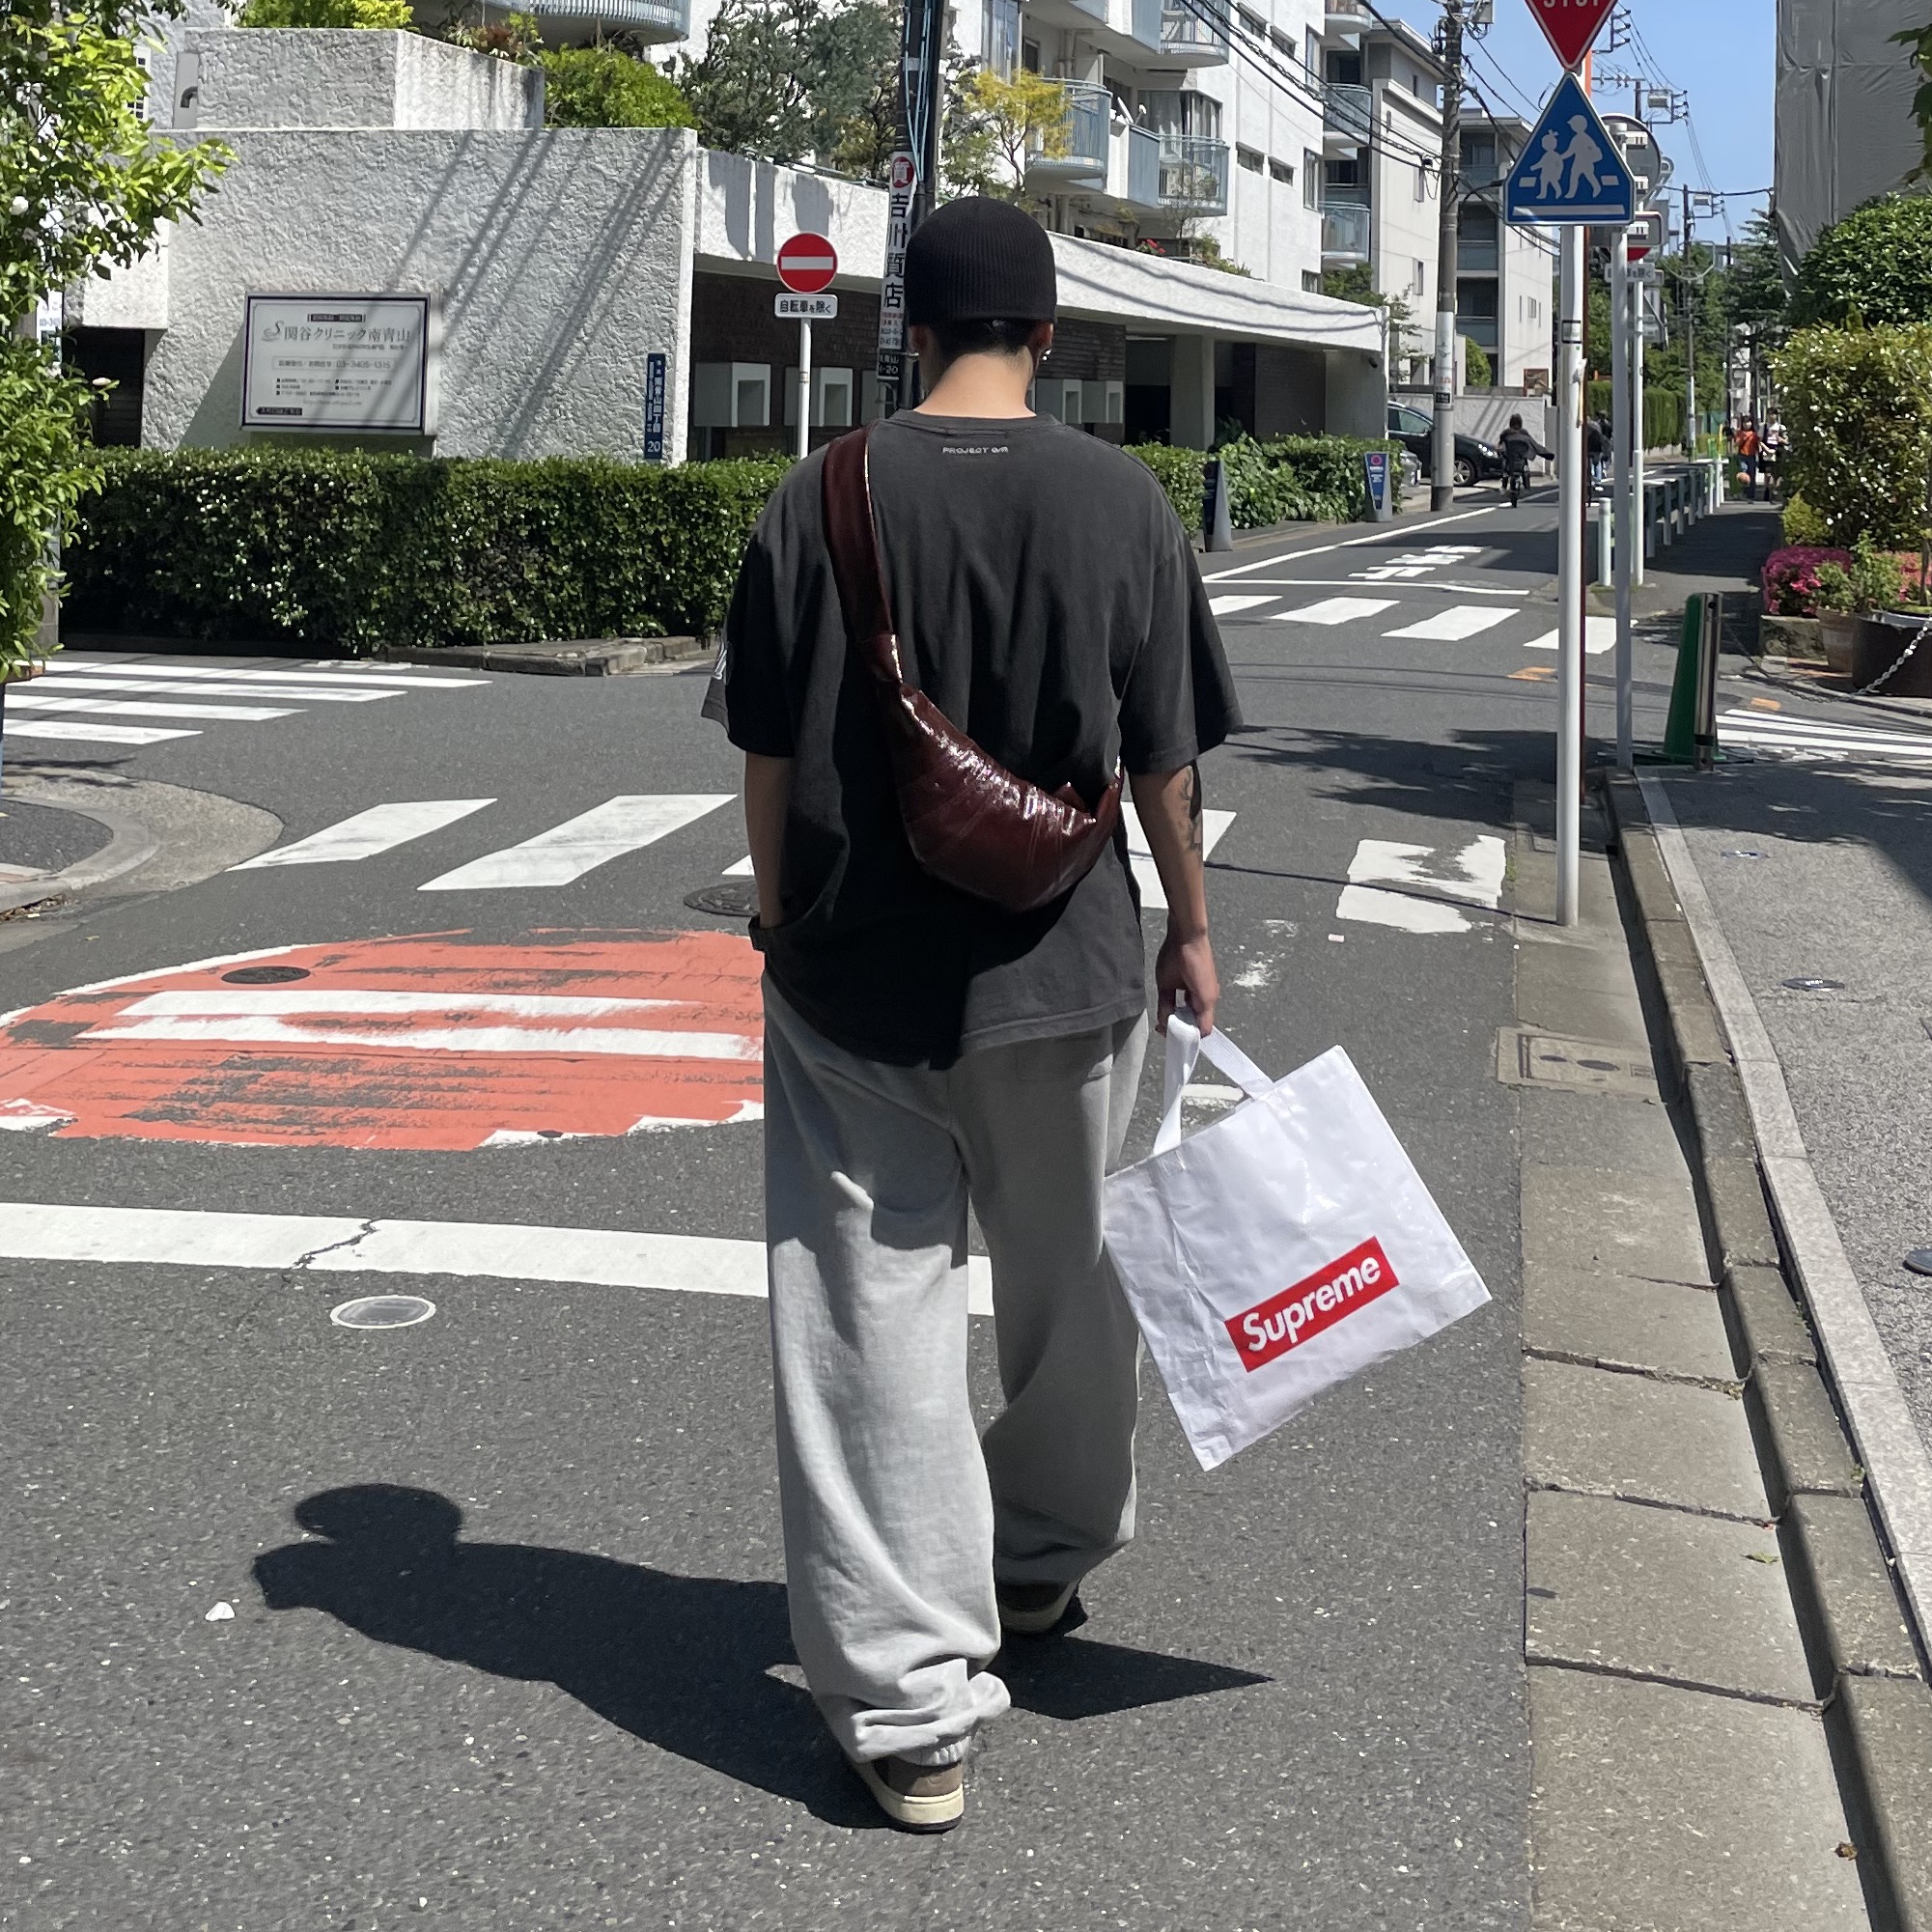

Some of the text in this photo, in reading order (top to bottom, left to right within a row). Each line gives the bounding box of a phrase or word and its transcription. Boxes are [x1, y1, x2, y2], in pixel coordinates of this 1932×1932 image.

[780, 299, 831, 313] 自転車を除く
[647, 440, 661, 452] 20
[1243, 1256, 1381, 1351] Supreme
